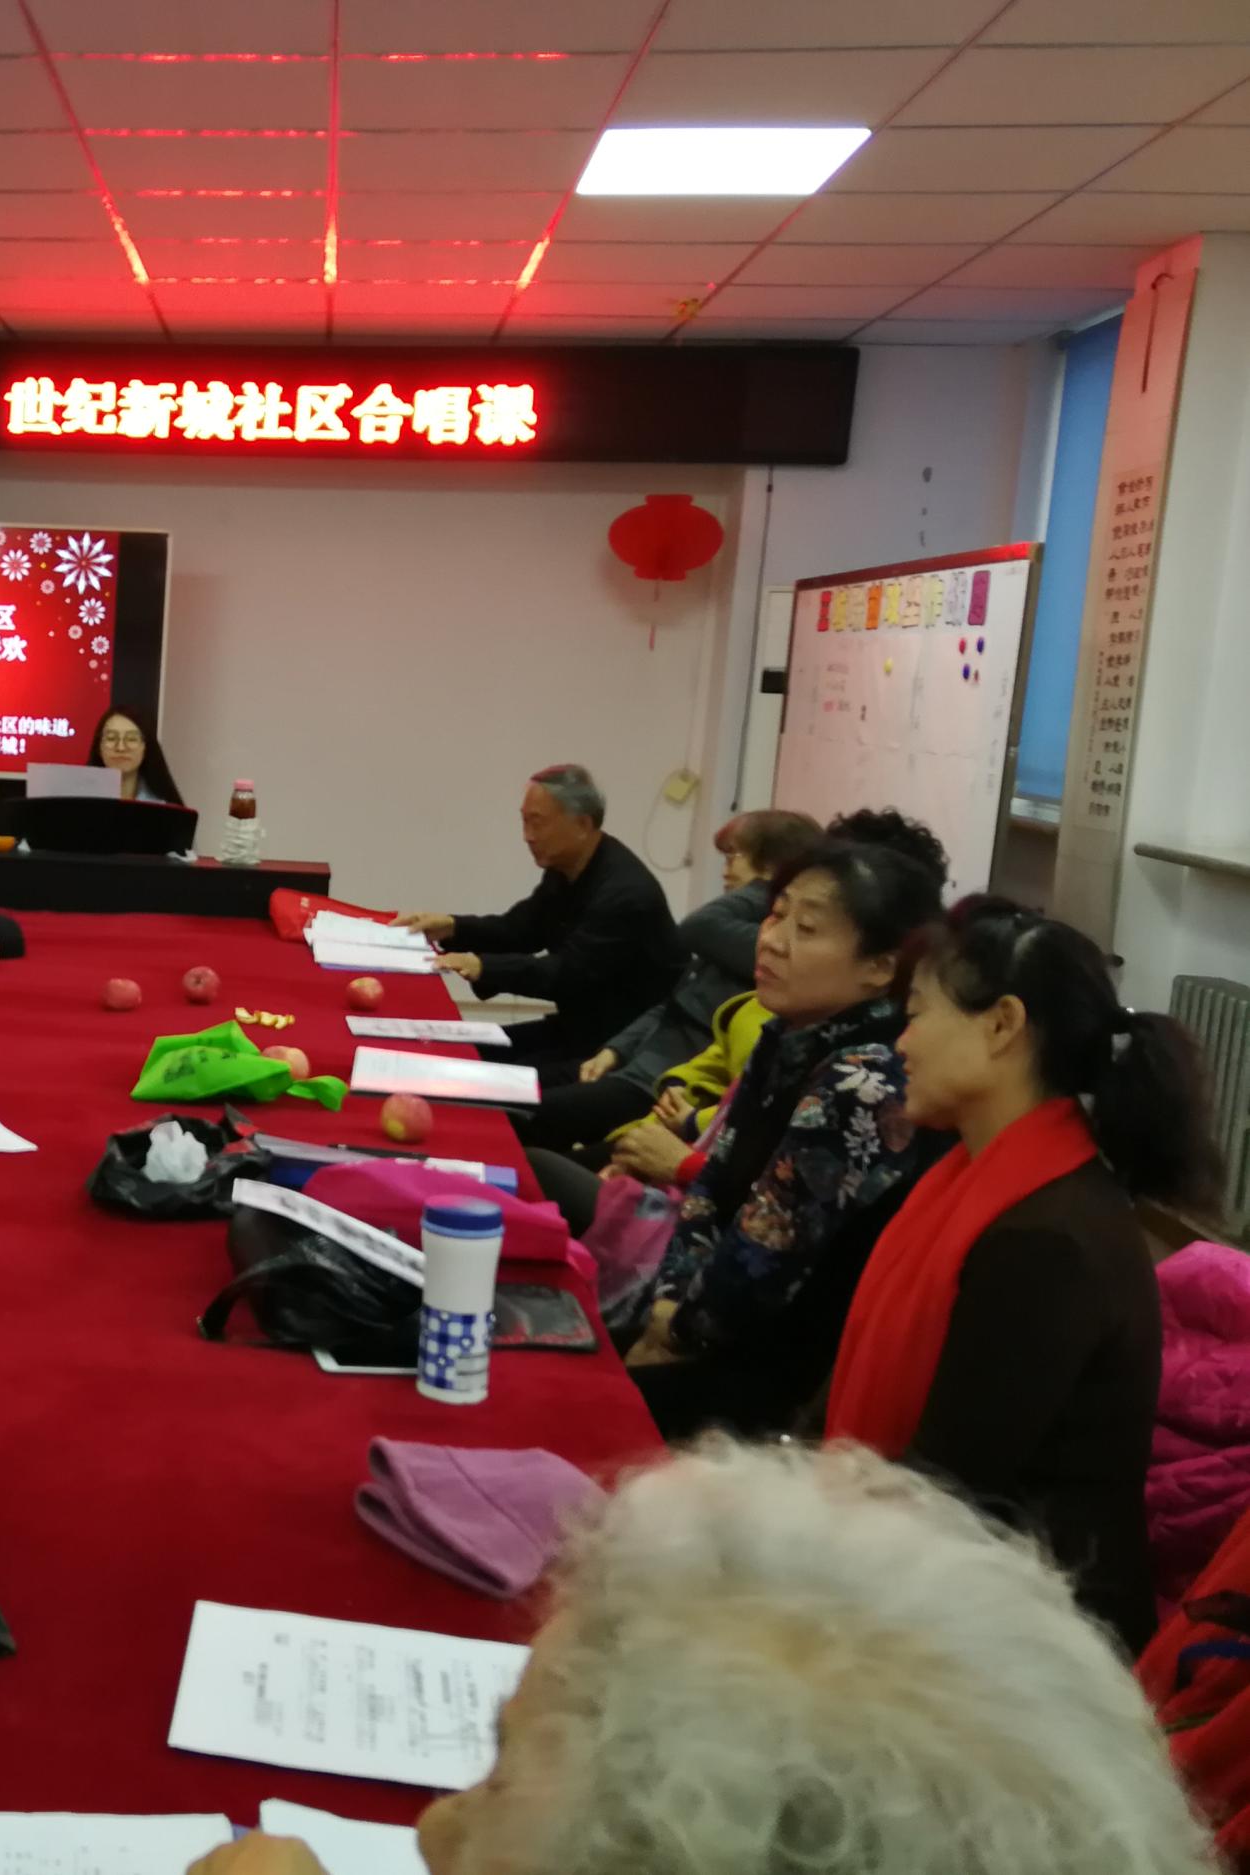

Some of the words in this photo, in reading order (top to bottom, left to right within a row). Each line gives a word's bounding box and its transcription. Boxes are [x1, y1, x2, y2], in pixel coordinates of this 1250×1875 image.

[5, 377, 537, 445] 世纪新城社区合唱课
